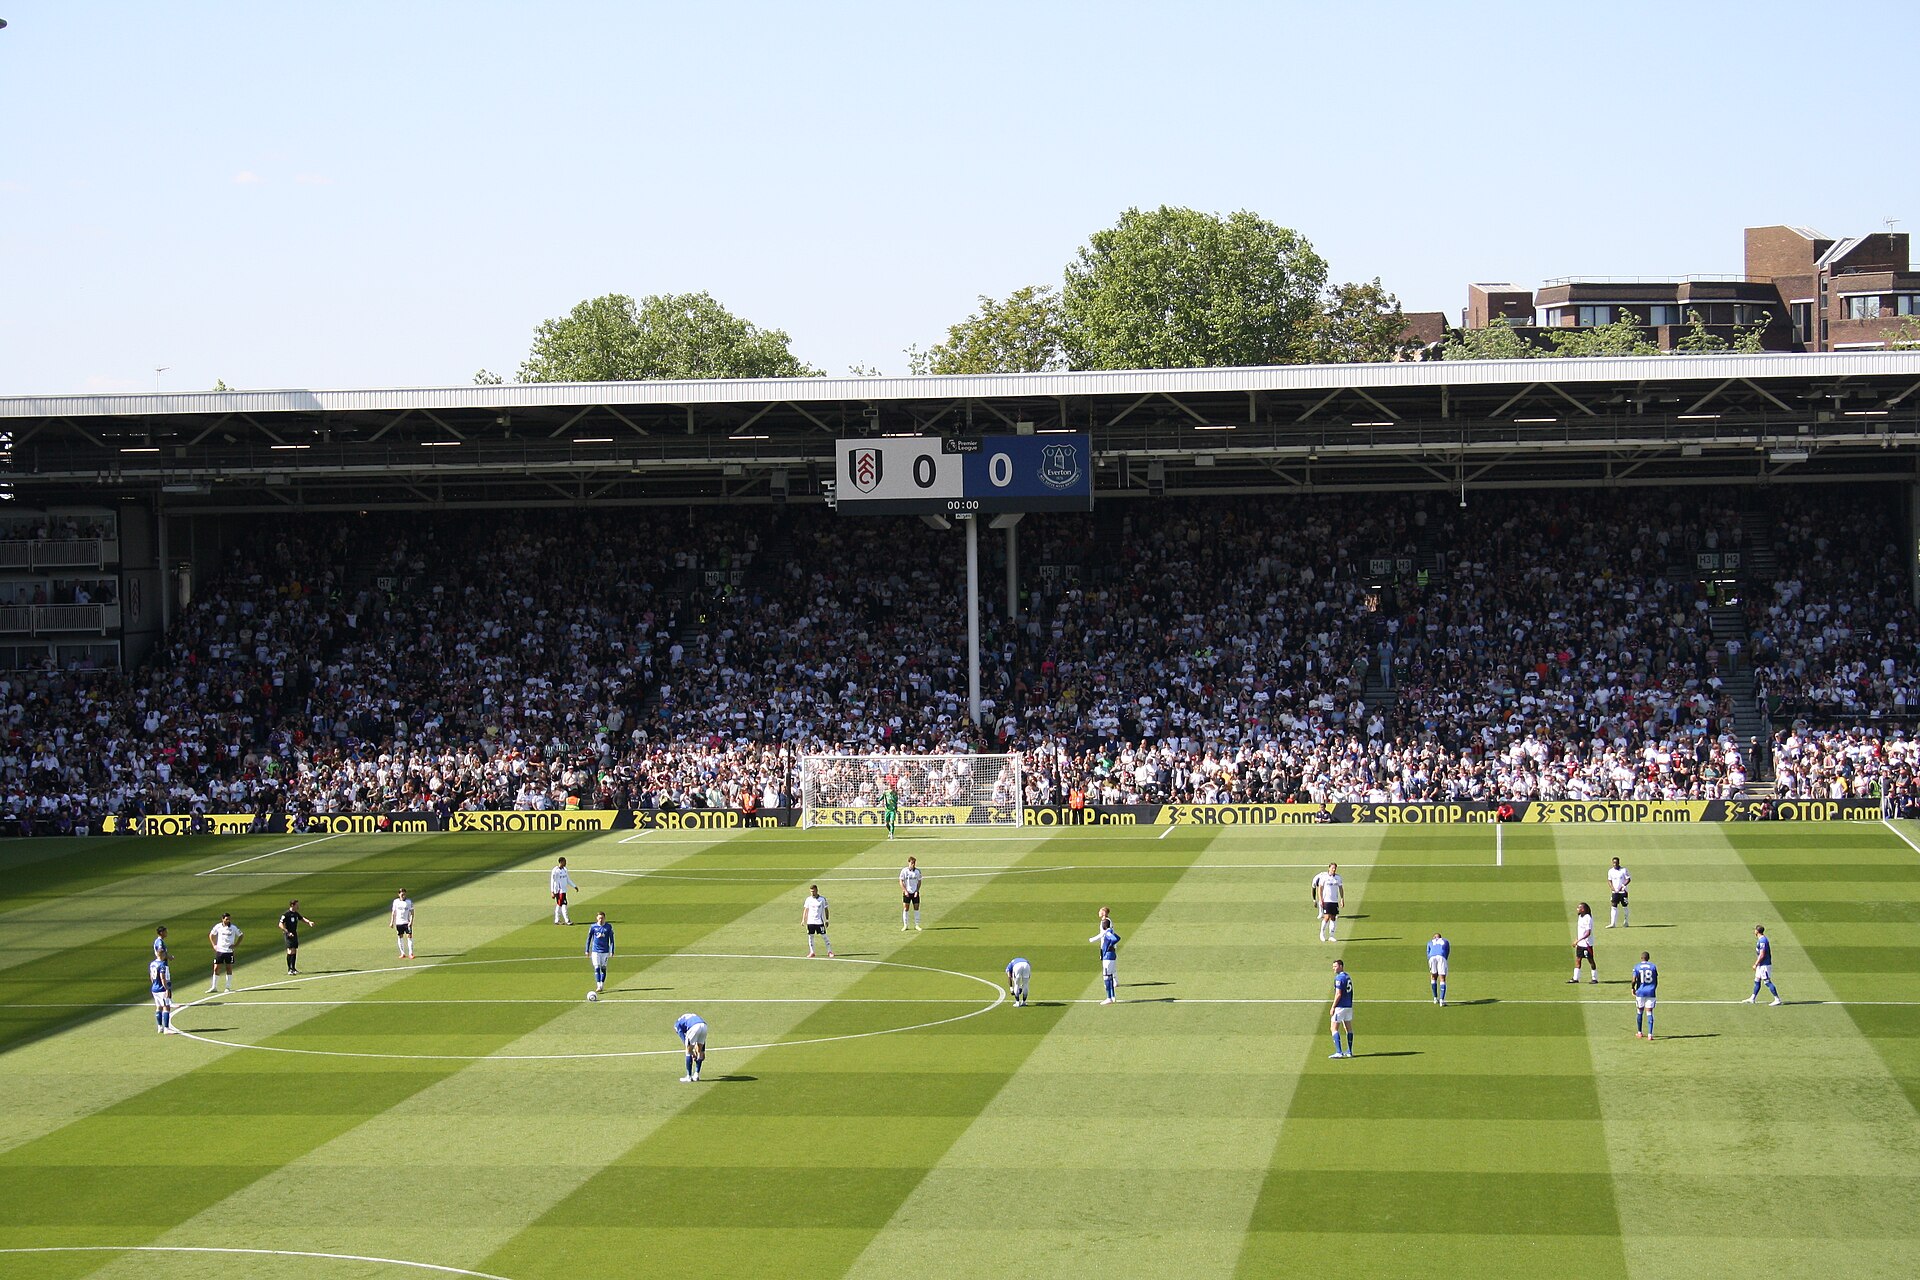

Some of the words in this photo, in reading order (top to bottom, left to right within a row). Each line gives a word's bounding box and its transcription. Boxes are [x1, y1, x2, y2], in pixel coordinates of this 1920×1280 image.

[912, 454, 937, 489] 0
[988, 452, 1013, 488] 0
[947, 501, 979, 509] 00:00
[1700, 555, 1711, 563] H3
[1727, 555, 1738, 563] H2
[1372, 561, 1384, 569] H4
[1399, 561, 1410, 569] H3
[707, 572, 718, 580] H6
[1749, 802, 1839, 820] SOTOP
[1639, 970, 1653, 984] 18
[1346, 980, 1352, 993] 5
